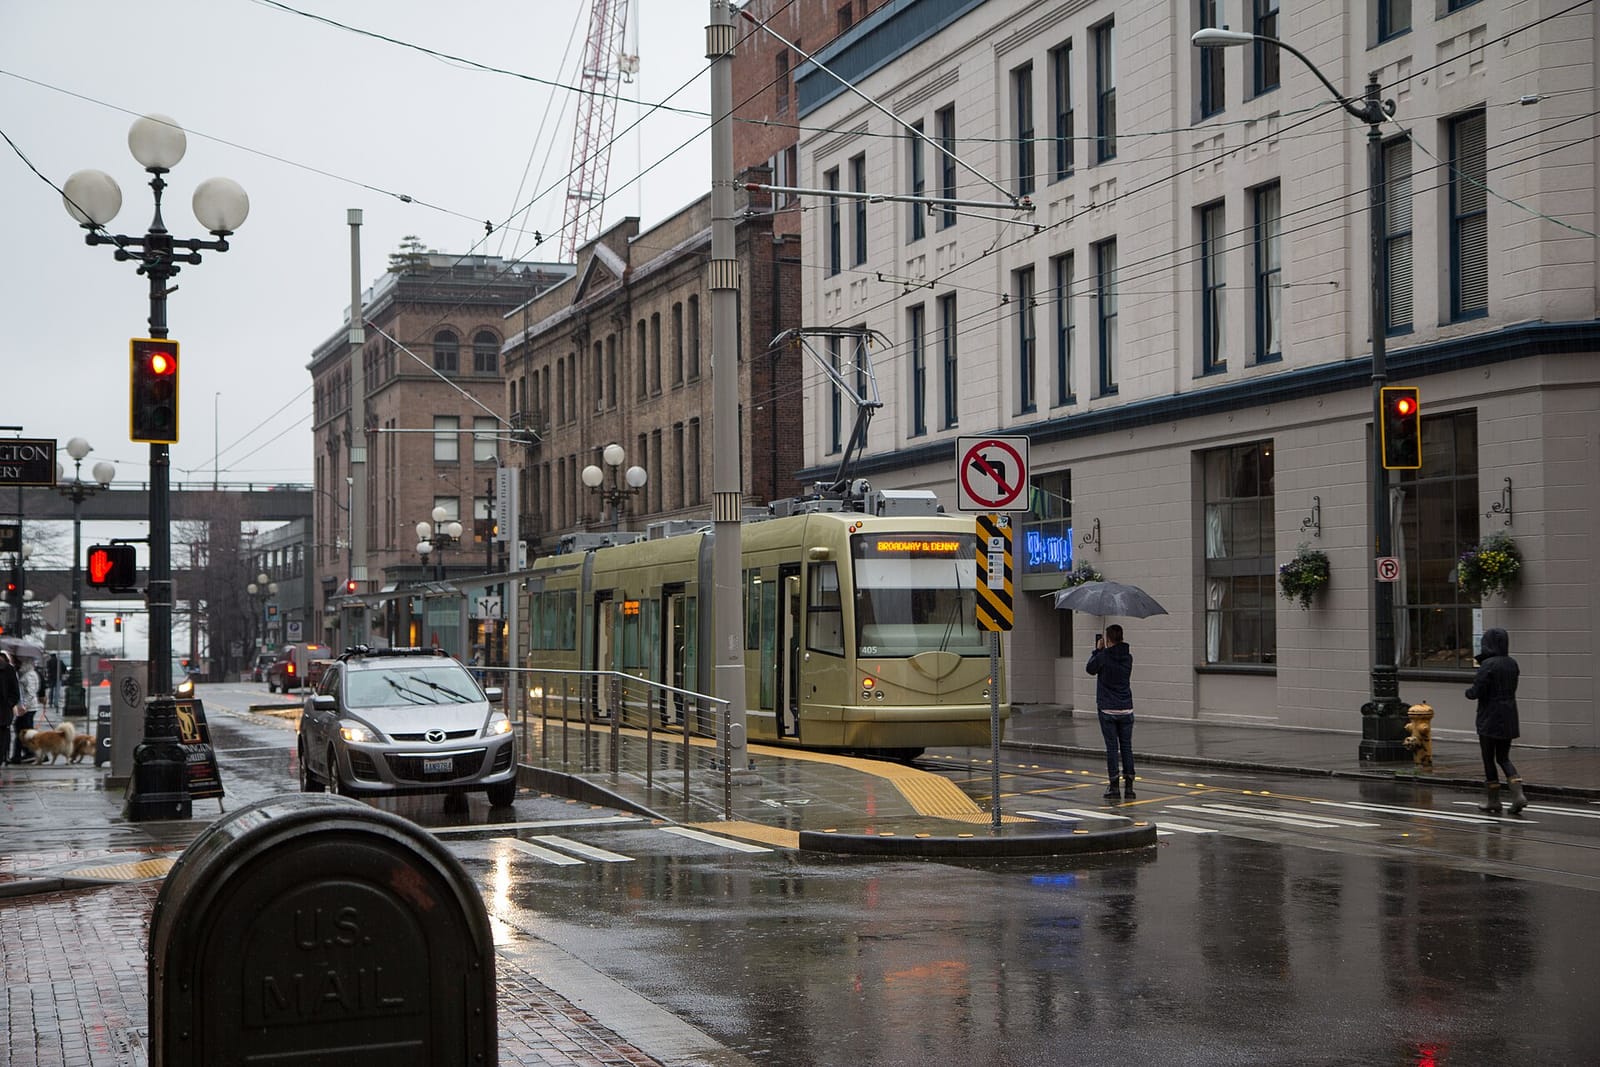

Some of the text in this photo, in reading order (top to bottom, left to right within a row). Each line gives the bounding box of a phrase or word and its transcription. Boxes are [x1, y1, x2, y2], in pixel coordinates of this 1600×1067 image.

[877, 541, 921, 552] BROADWAY
[930, 541, 960, 552] DENNY
[862, 646, 878, 655] 405
[295, 905, 372, 950] U.S.
[262, 965, 405, 1019] MAIL
